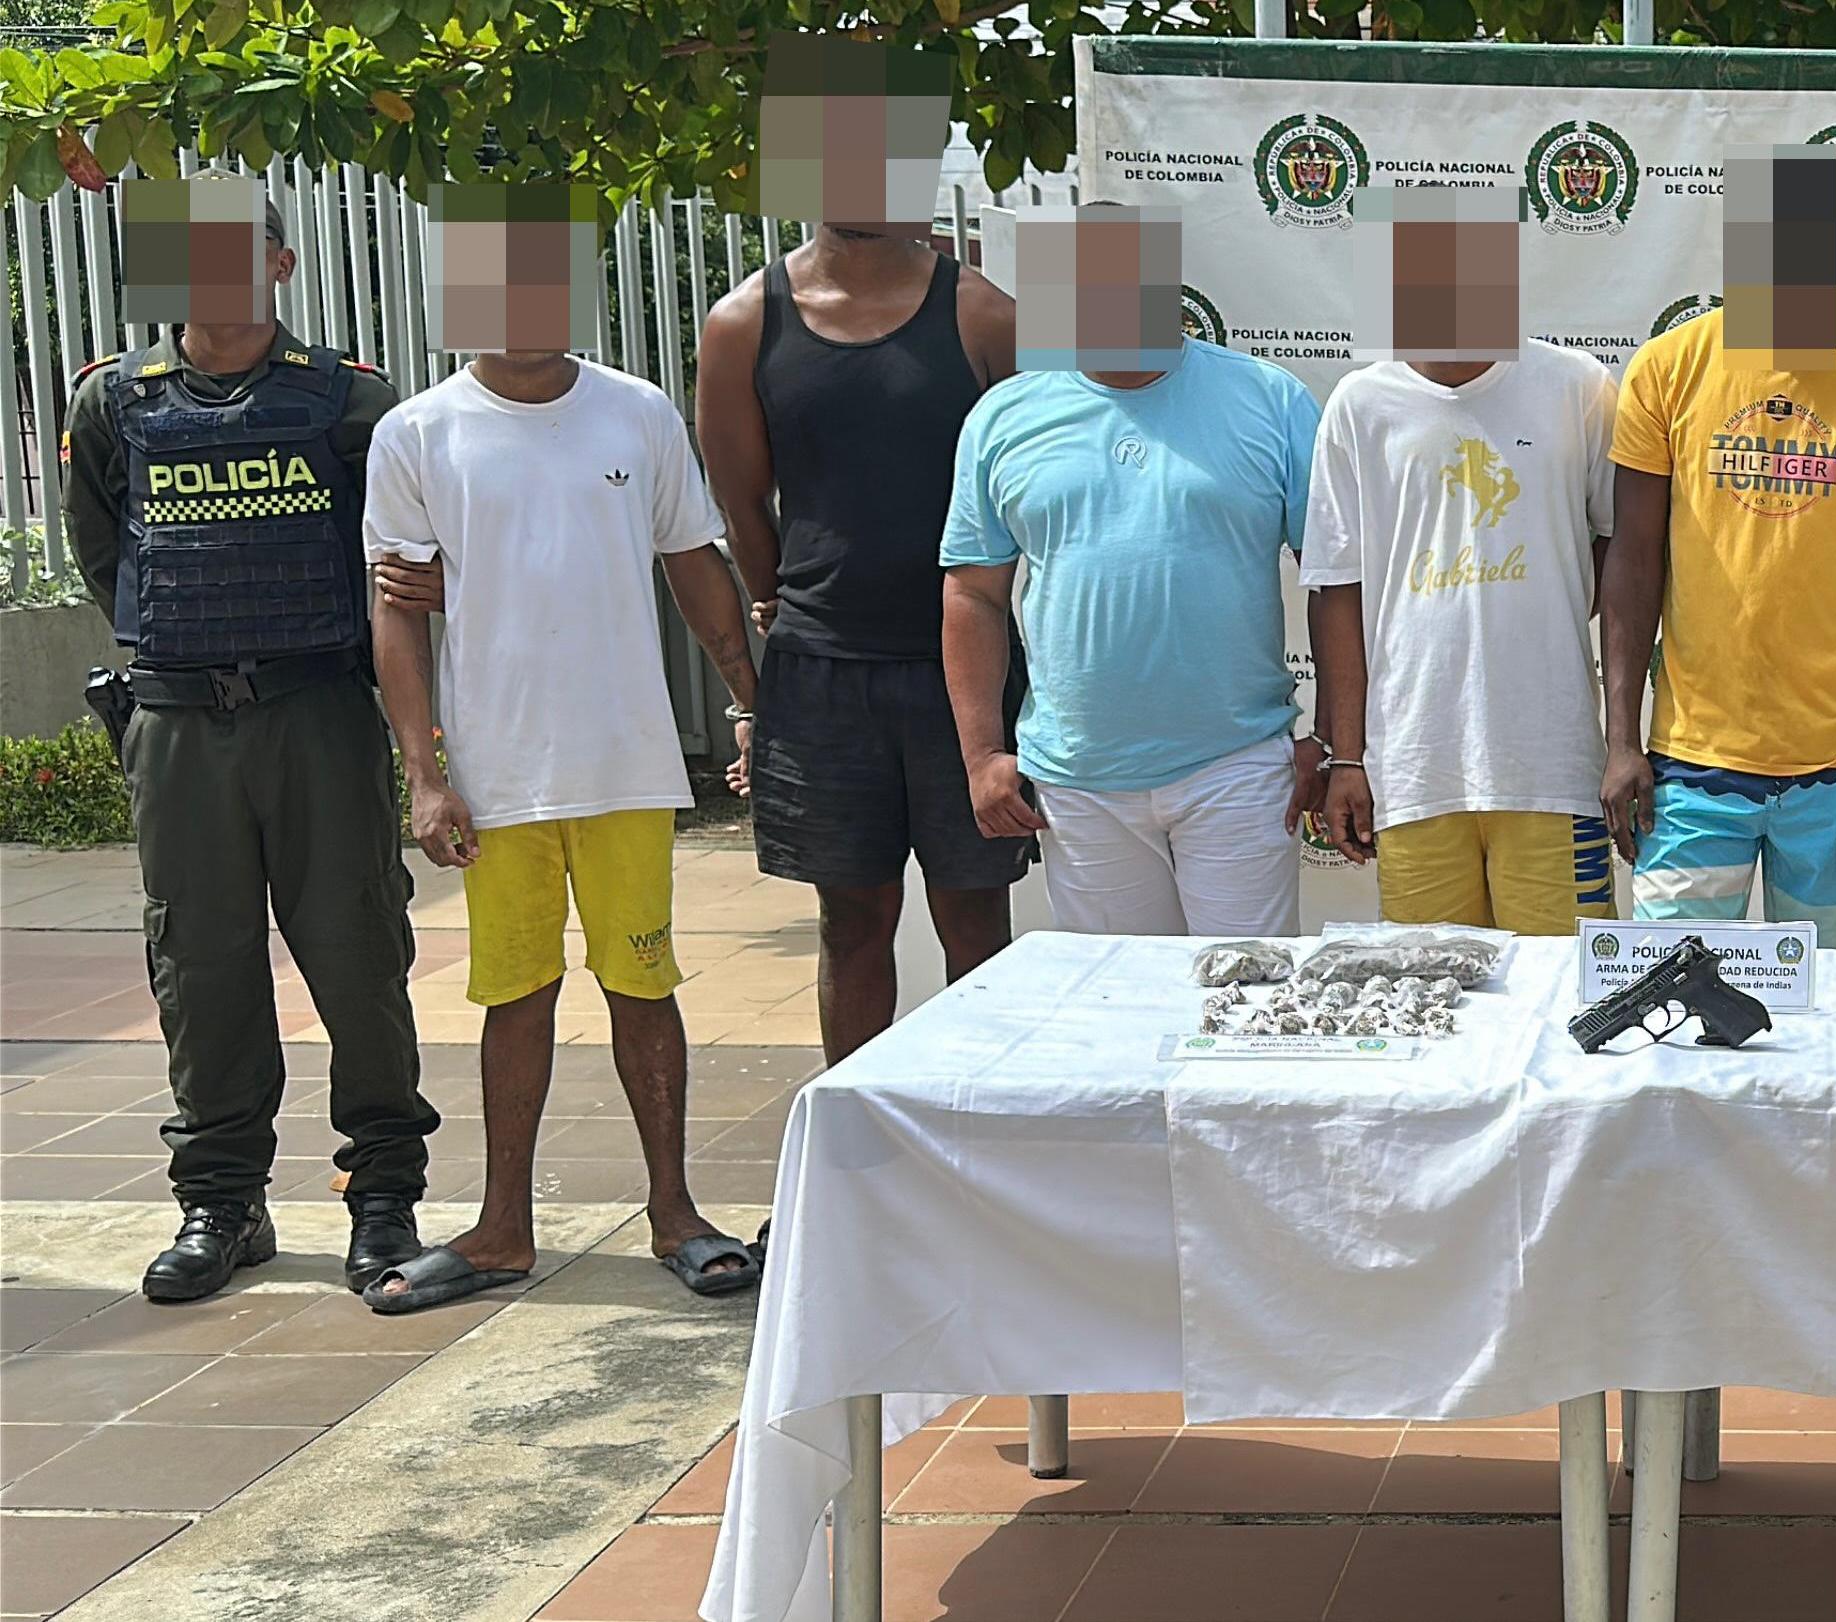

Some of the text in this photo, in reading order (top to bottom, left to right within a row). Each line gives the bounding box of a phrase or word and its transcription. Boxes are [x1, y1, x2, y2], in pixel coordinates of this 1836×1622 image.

[1106, 150, 1243, 166] POLICÍA NACIONAL
[1328, 133, 1356, 180] COLOMBIA
[1598, 140, 1625, 185] COLOMBIA
[1376, 160, 1515, 174] POLICÍA NACIONAL
[1646, 165, 1704, 177] POLICÍA
[1124, 169, 1224, 183] DE COLOMBIA
[1664, 184, 1684, 194] DE
[1313, 189, 1353, 215] NACIONAL
[1583, 196, 1622, 221] NACIONAL
[1313, 213, 1344, 226] PATRIA
[1582, 220, 1612, 232] PATRIA
[1232, 328, 1353, 342] POLICÍA NACION
[1564, 336, 1638, 348] NACIONAL
[1250, 347, 1352, 360] DE COLOMBIA
[1724, 400, 1764, 429] PREMIUM
[1795, 404, 1832, 436] QUALITY
[149, 448, 317, 496] POLICÍA
[1722, 453, 1828, 478] HILFIGER
[1409, 544, 1527, 596] Gabriela
[1596, 964, 1646, 974] ARMA DE
[1744, 967, 1798, 976] REDUCIDA
[1753, 980, 1764, 988] de
[1766, 980, 1792, 990] Indias
